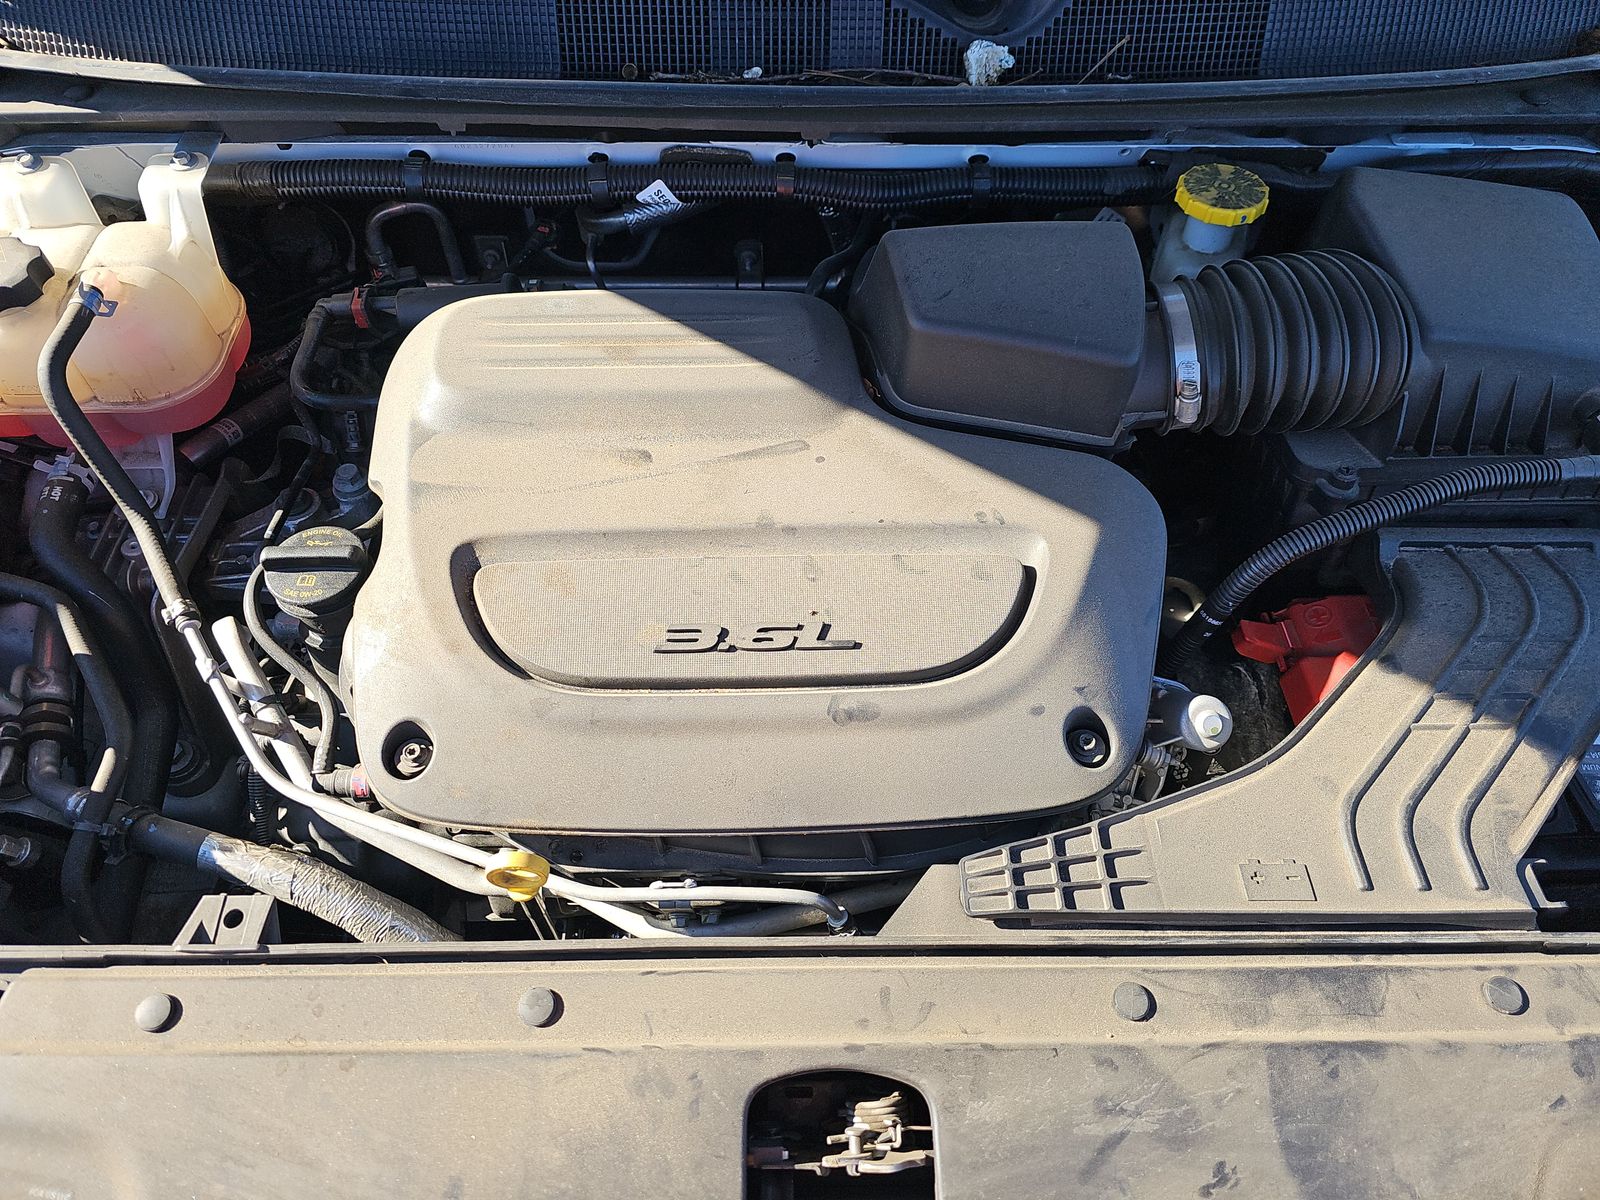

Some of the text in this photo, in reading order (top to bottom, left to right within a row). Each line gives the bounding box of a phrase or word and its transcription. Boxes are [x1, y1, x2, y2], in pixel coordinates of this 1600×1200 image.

[50, 485, 64, 502] HOT
[302, 528, 344, 538] ENGINE OIL
[283, 588, 323, 597] SAE 0W-20
[653, 621, 862, 653] 3.6L
